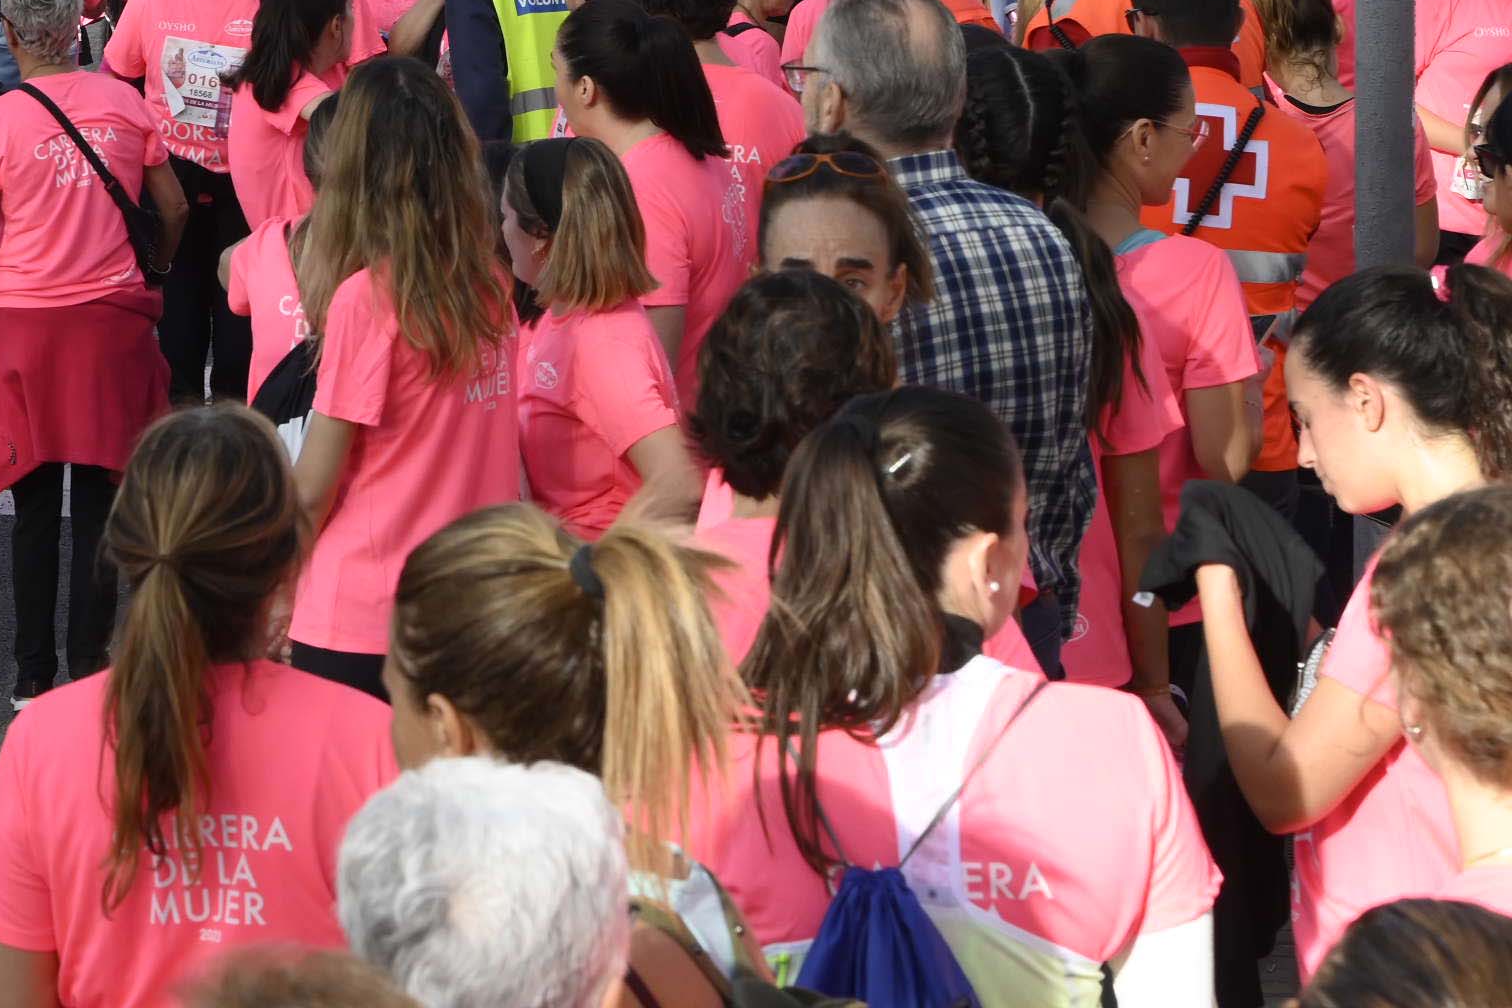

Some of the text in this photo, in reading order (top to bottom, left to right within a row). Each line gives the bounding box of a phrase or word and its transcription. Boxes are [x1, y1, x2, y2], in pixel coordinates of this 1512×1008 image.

[158, 21, 196, 32] OYSHO
[188, 73, 218, 88] 016
[33, 126, 118, 161] CARERA
[217, 851, 258, 889] LA
[149, 888, 267, 926] MUJER
